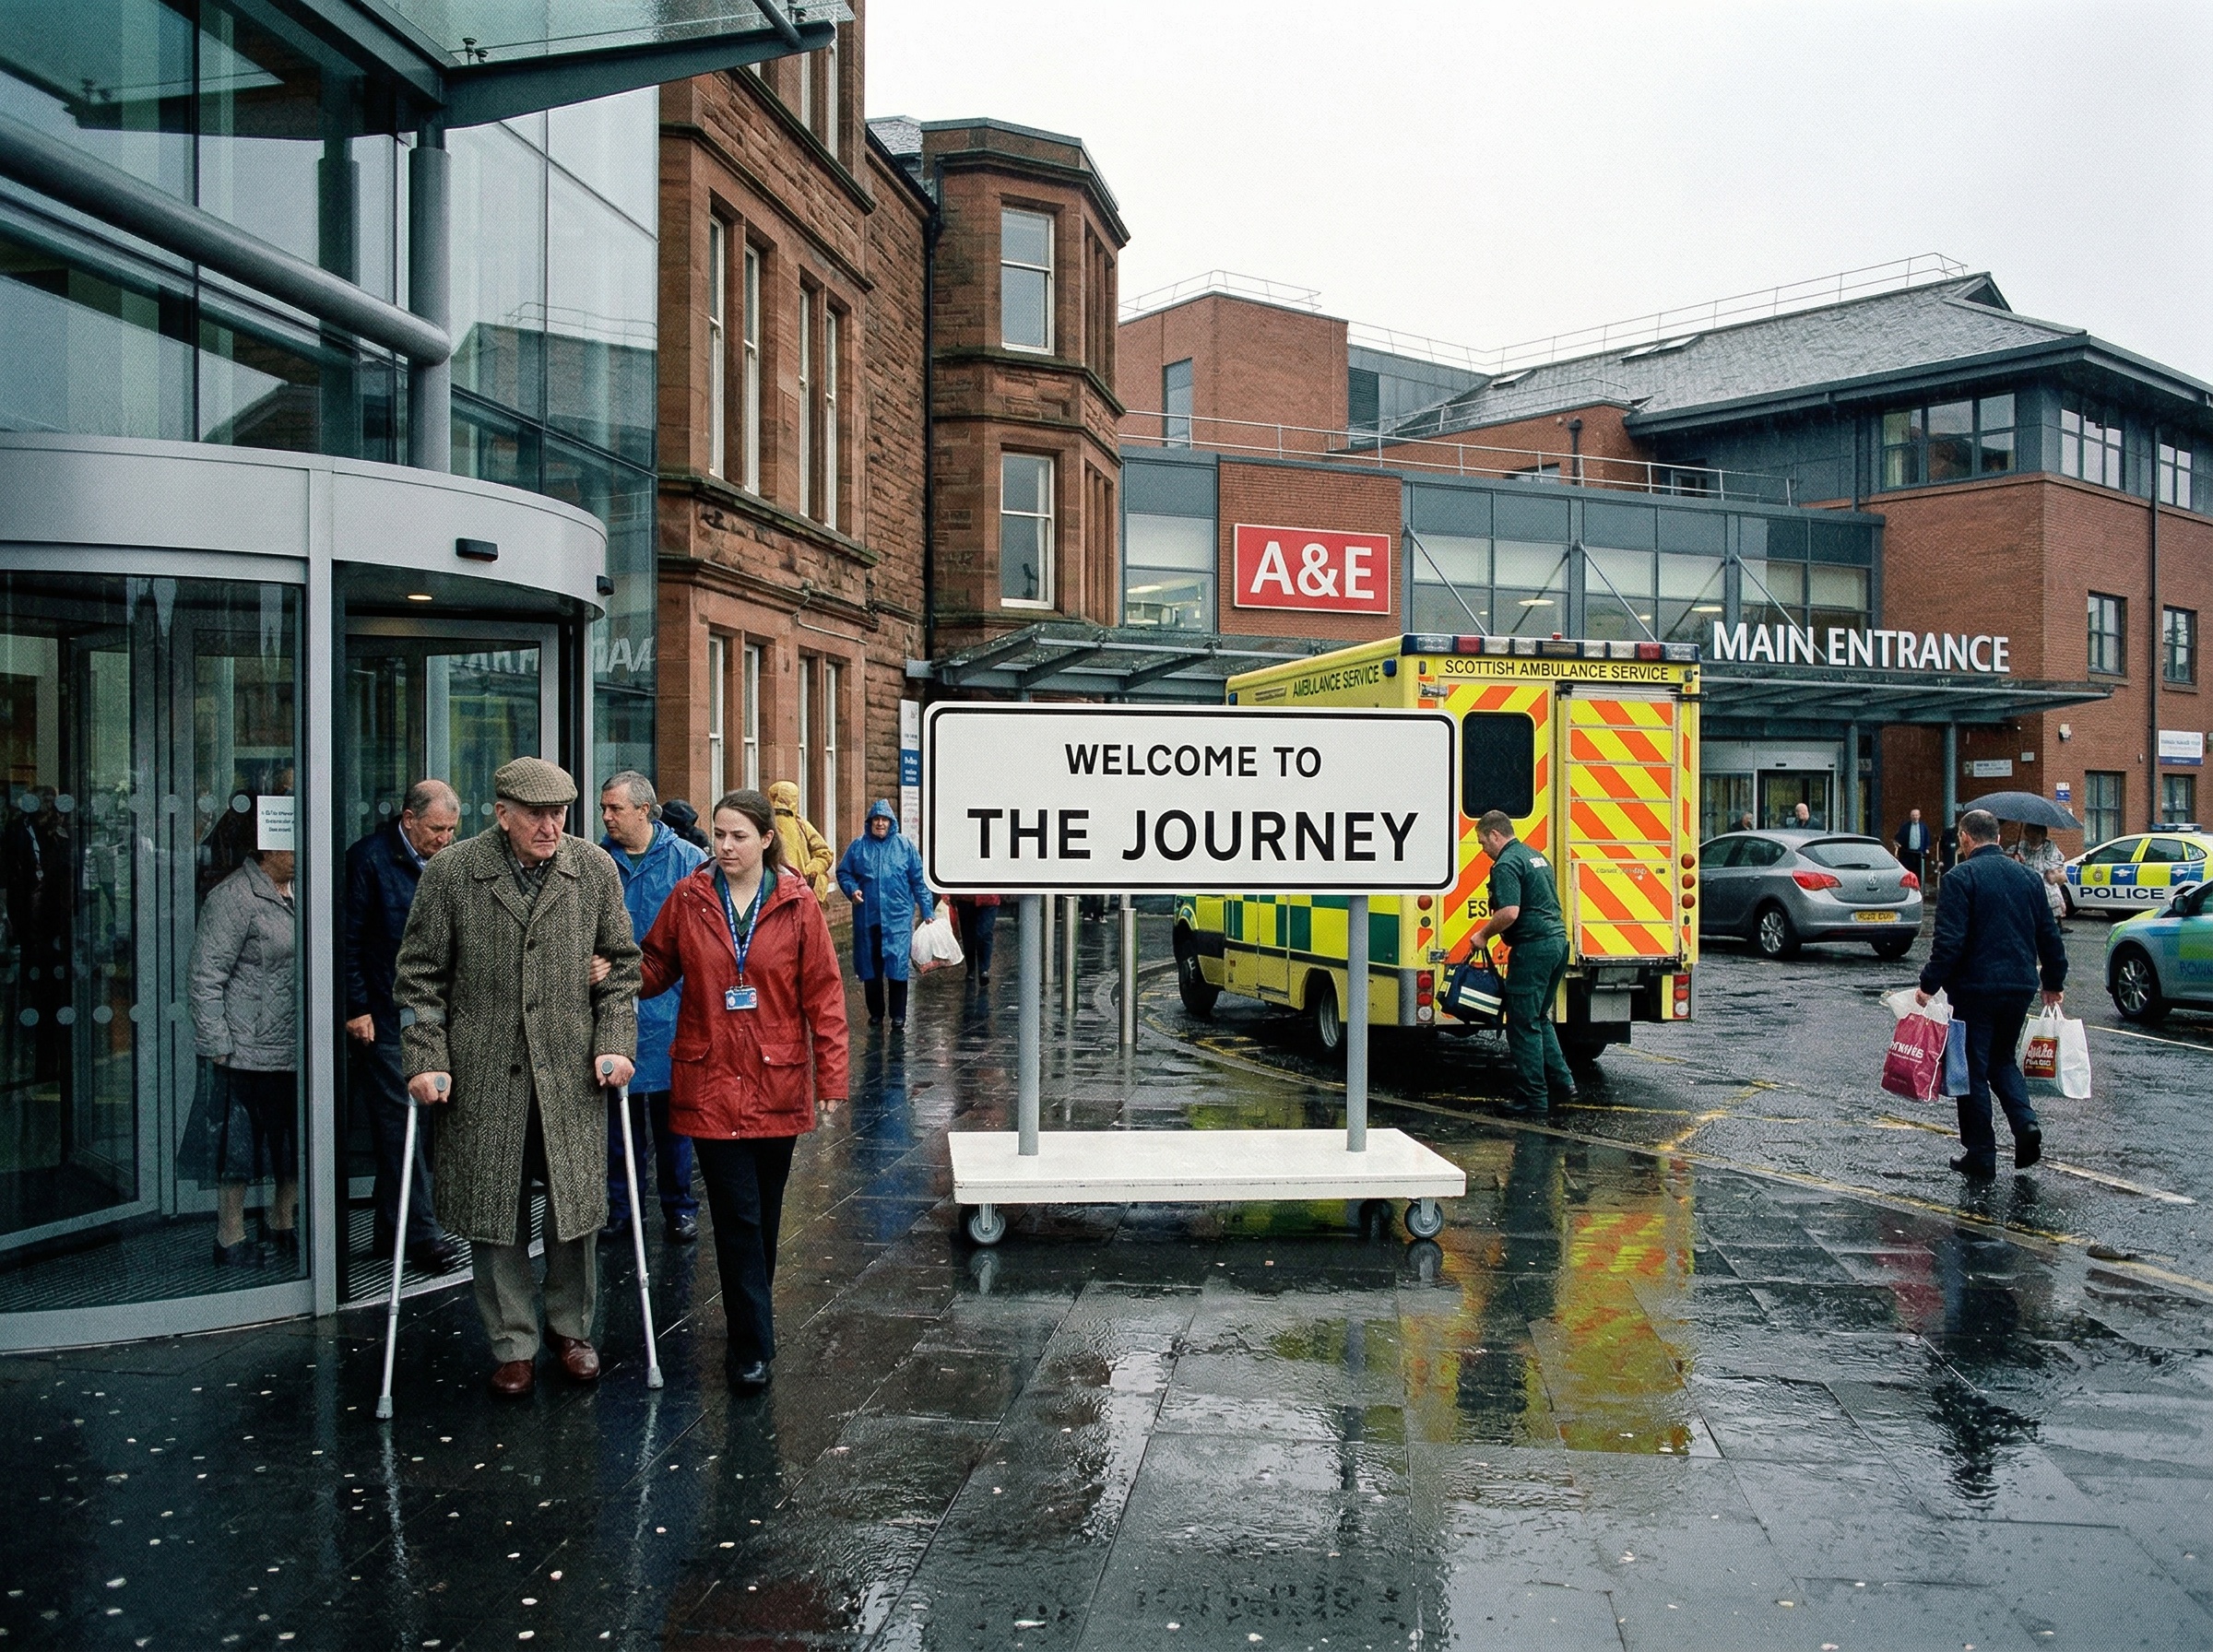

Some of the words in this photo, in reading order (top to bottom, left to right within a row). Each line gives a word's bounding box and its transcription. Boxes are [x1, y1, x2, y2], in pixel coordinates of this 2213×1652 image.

[1249, 540, 1375, 599] A&E
[1713, 620, 1815, 665] MAIN
[1828, 627, 2010, 672] ENTRANCE
[1293, 672, 1341, 698] AMBULANCE
[1343, 665, 1379, 690] SERVICE
[1445, 659, 1515, 675] SCOTTISH
[1520, 662, 1607, 678] AMBULANCE
[1611, 665, 1669, 680] SERVICE
[1064, 743, 1258, 777] WELCOME
[1272, 746, 1321, 778] TO
[966, 808, 1091, 860] THE
[1121, 809, 1419, 862] JOURNEY
[2079, 887, 2165, 900] POLICE
